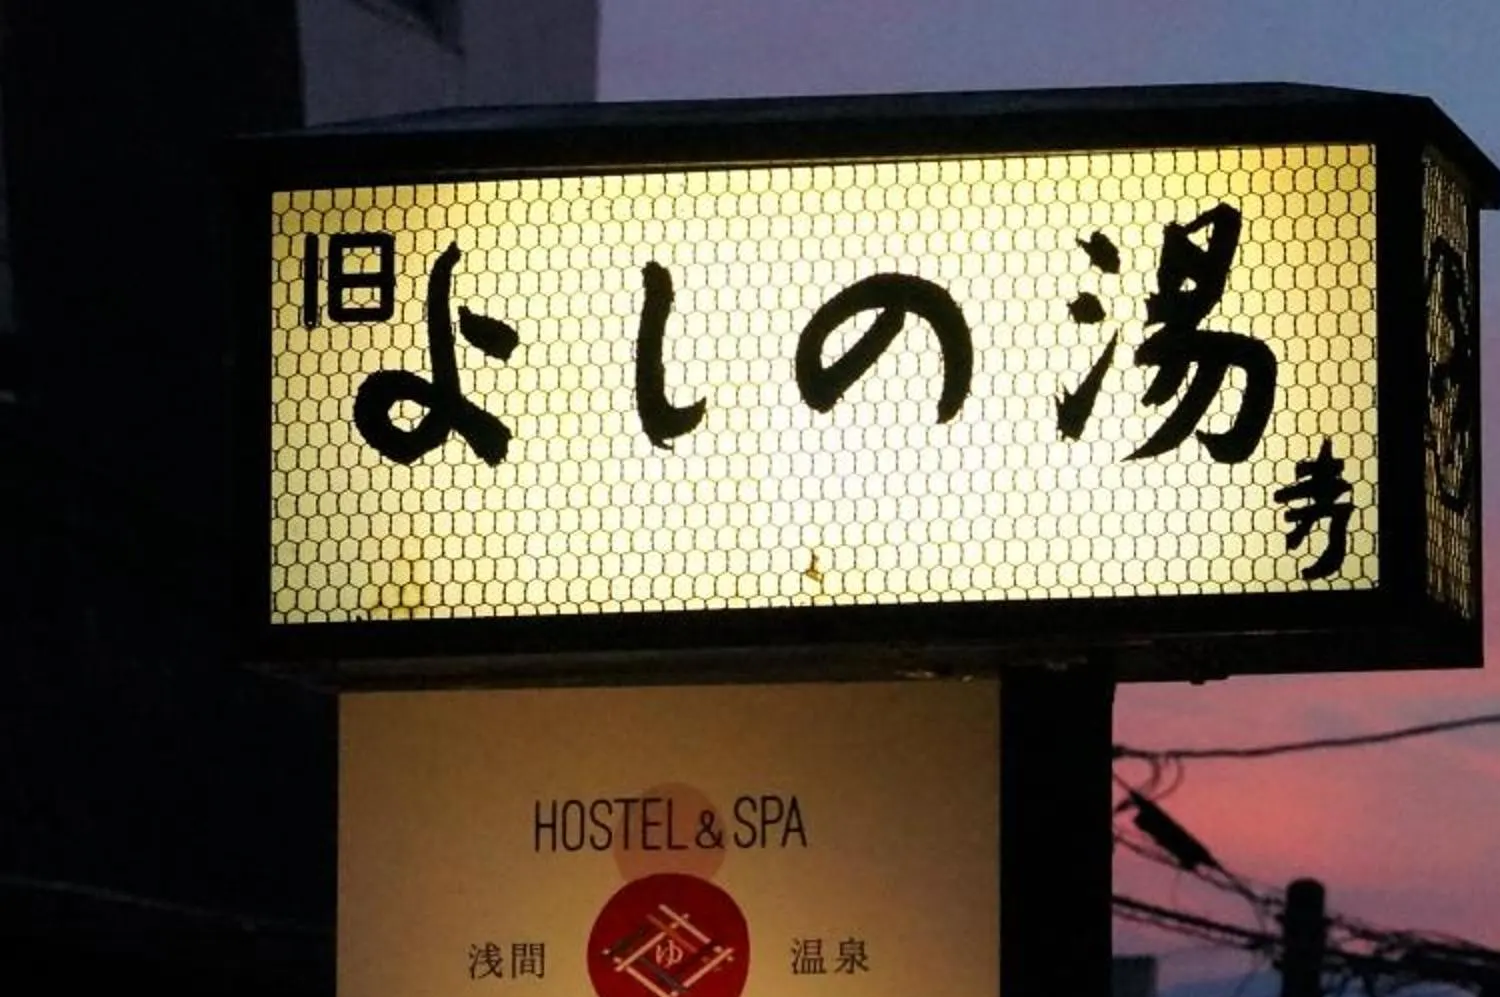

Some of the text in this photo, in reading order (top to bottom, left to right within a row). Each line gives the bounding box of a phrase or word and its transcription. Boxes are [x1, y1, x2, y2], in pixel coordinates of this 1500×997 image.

[303, 232, 396, 329] 旧
[352, 202, 1277, 467] よしの湯
[533, 795, 807, 852] HOSTEL & SPA
[467, 936, 871, 980] 浅間 温泉
